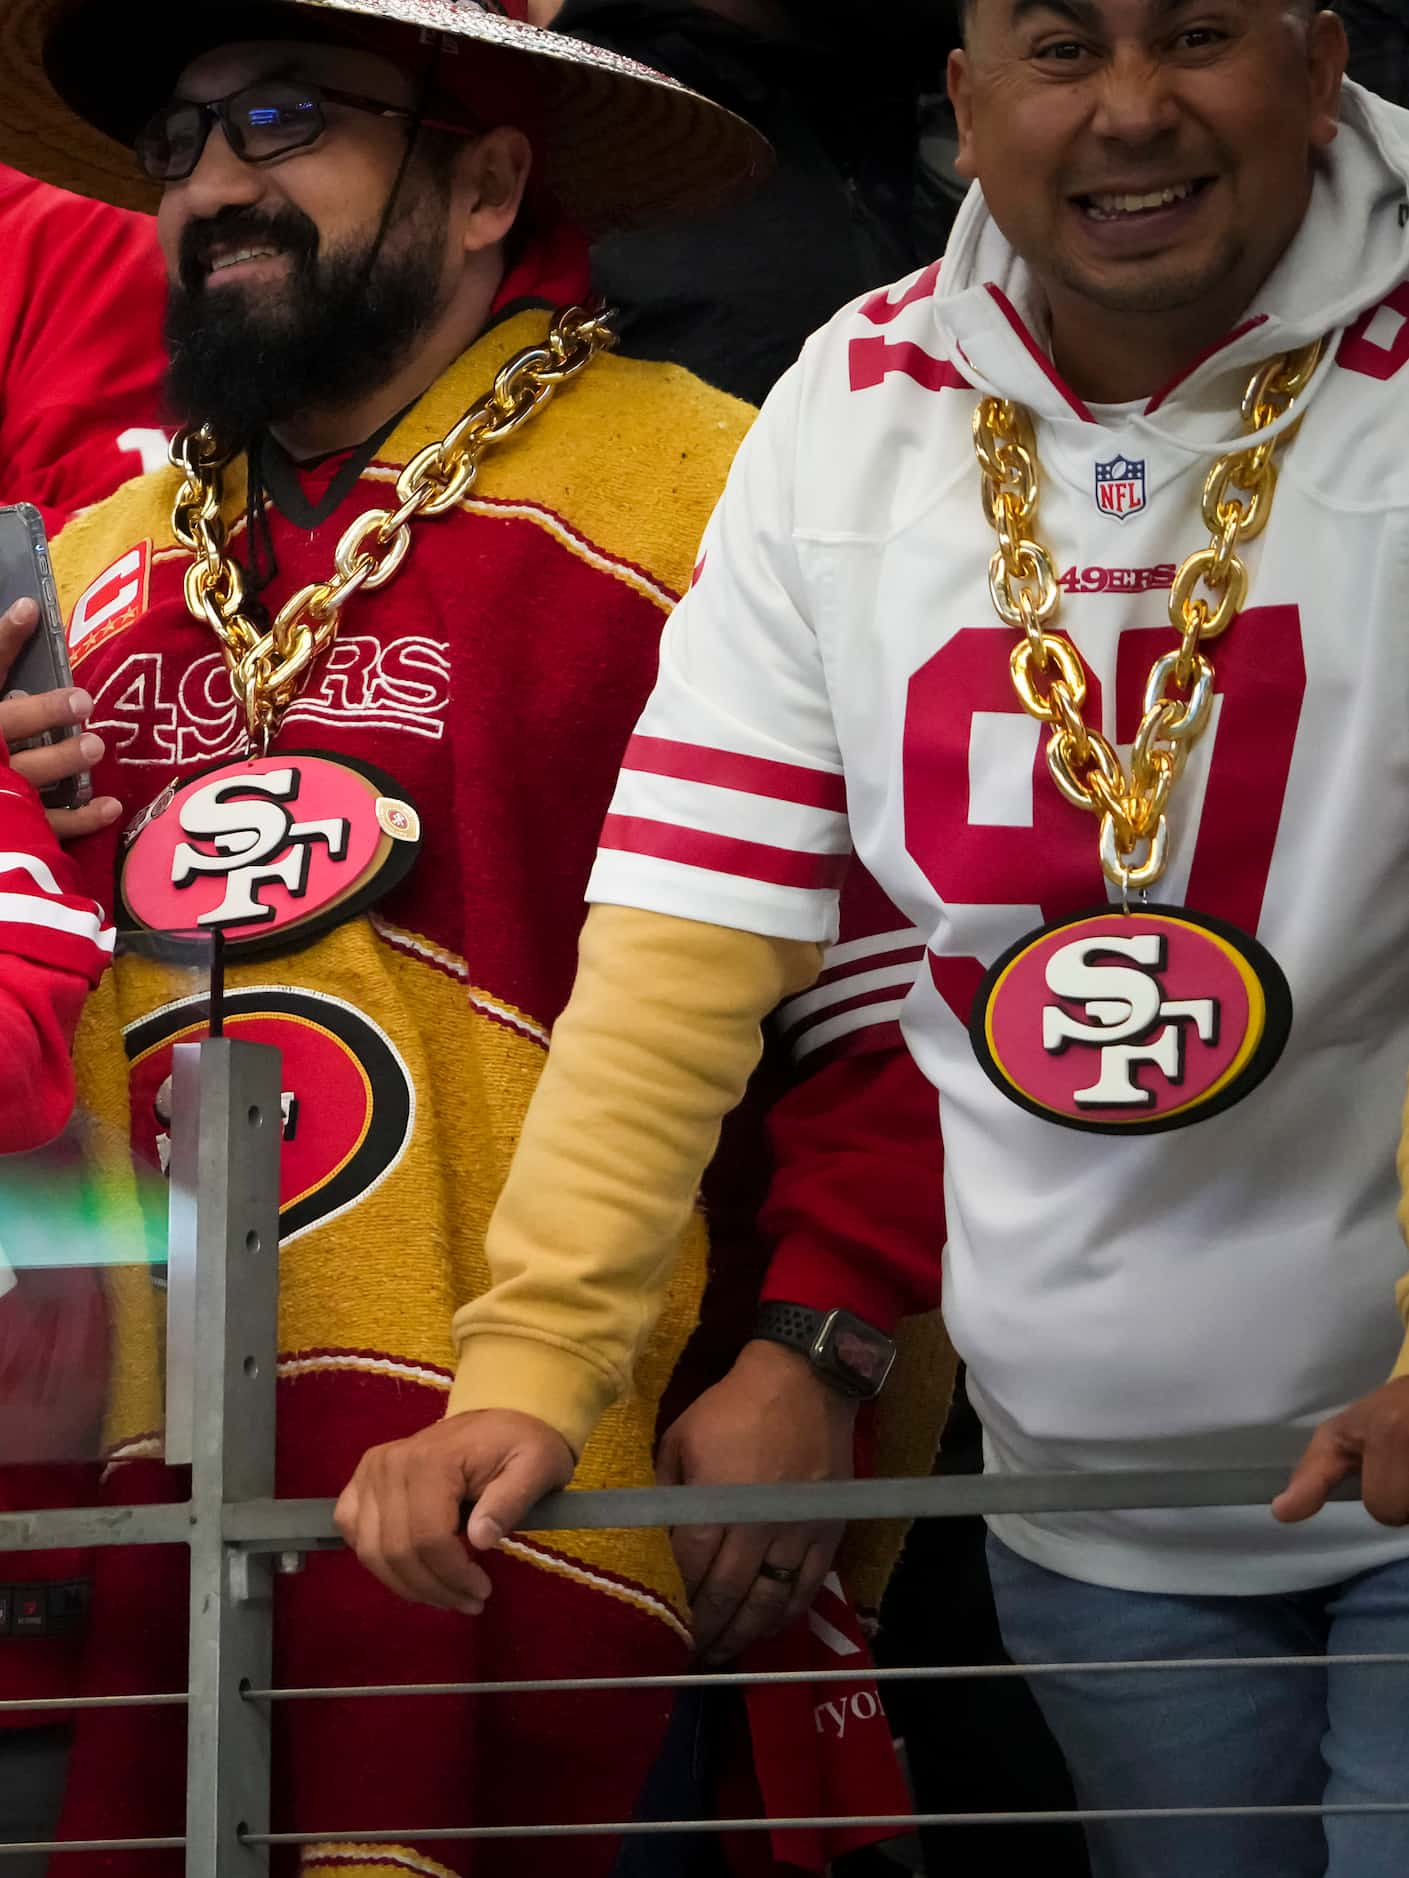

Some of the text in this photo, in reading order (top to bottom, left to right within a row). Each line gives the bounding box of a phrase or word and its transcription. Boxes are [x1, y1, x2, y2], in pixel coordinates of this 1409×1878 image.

[1099, 481, 1142, 513] NFL
[1056, 562, 1177, 594] 49ERS
[84, 635, 452, 766] 49RS
[170, 767, 351, 930] SF
[1042, 934, 1223, 1110] SF
